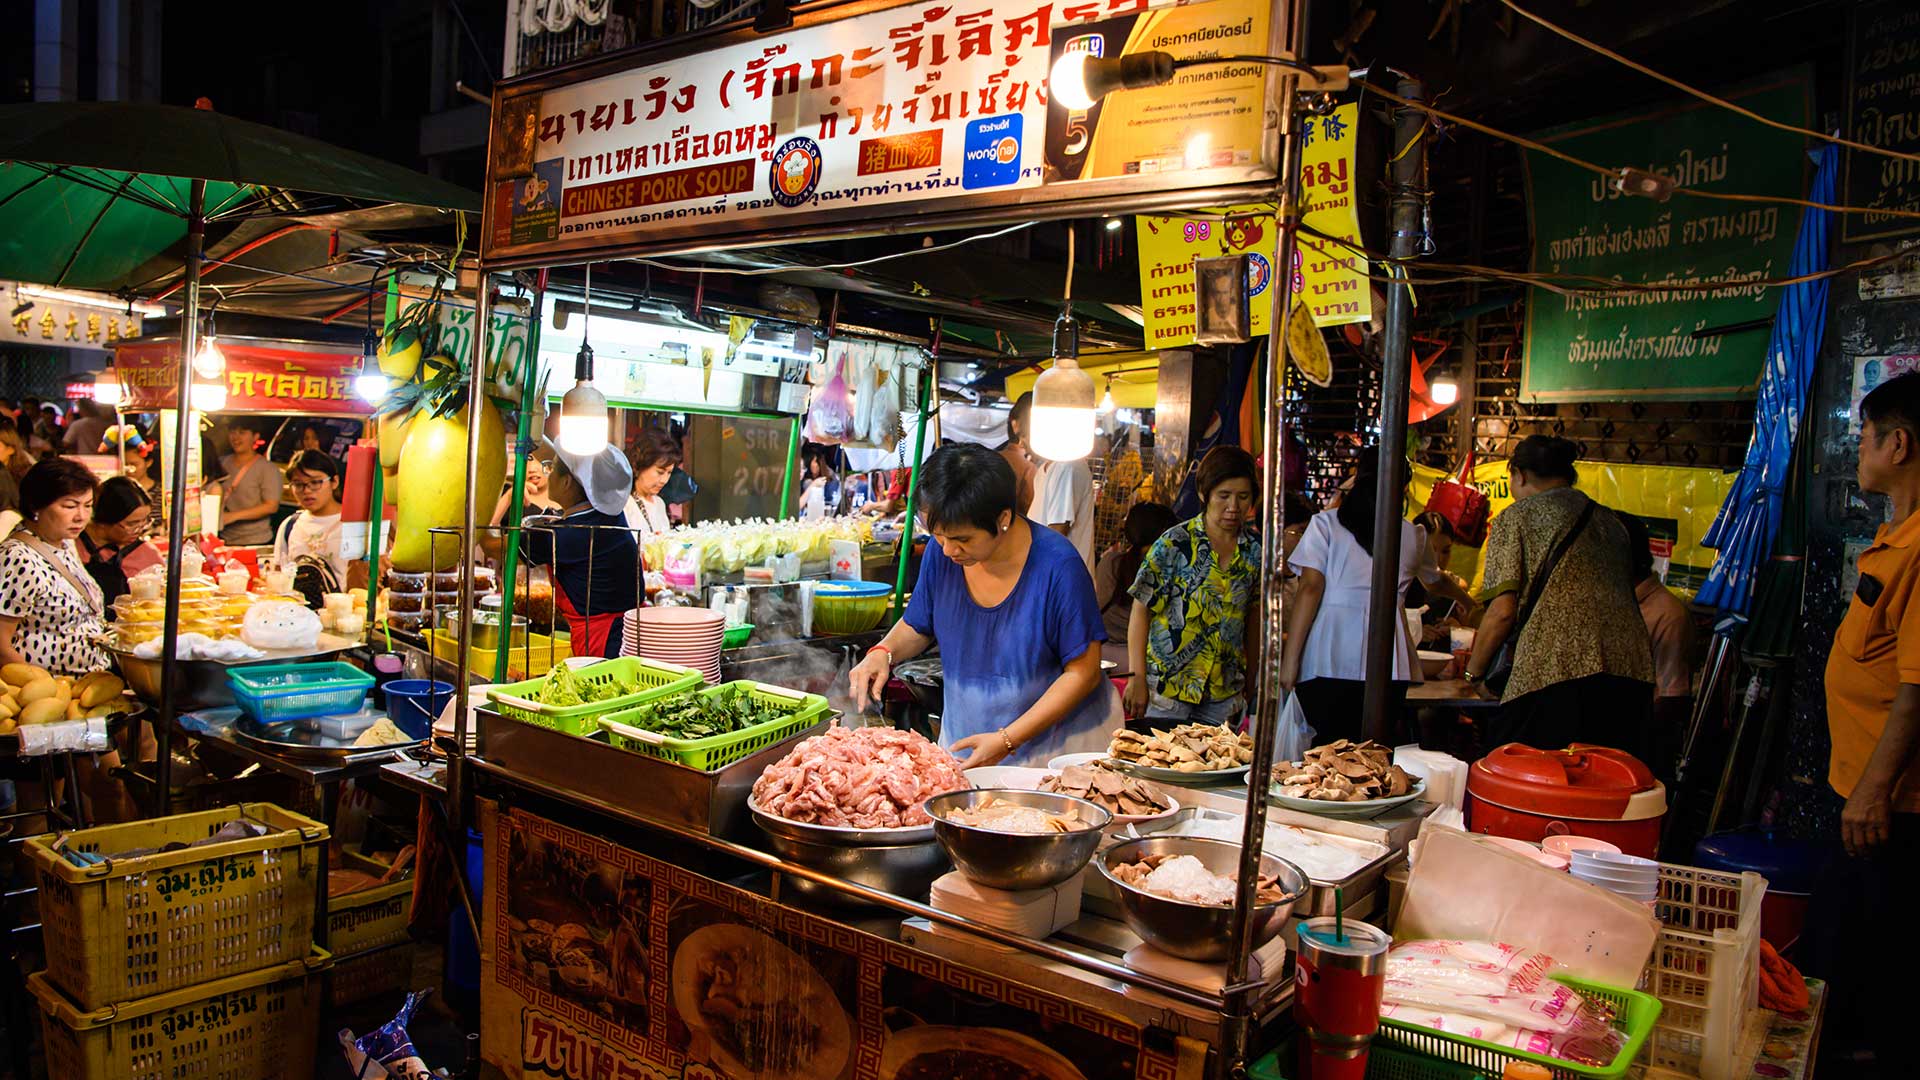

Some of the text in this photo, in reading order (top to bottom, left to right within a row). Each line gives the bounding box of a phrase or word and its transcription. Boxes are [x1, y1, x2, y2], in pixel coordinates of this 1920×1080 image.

[568, 122, 778, 181] เกาเหลาเลือดหมู
[865, 134, 935, 173] 猪血汤
[567, 165, 748, 214] CHINESE PORK SOUP
[1184, 221, 1211, 242] 99
[1310, 257, 1356, 273] บาท
[1312, 279, 1357, 295] บาท
[1313, 301, 1359, 317] บาท
[745, 429, 780, 450] SRR
[733, 466, 784, 496] 207
[190, 885, 222, 897] 2017
